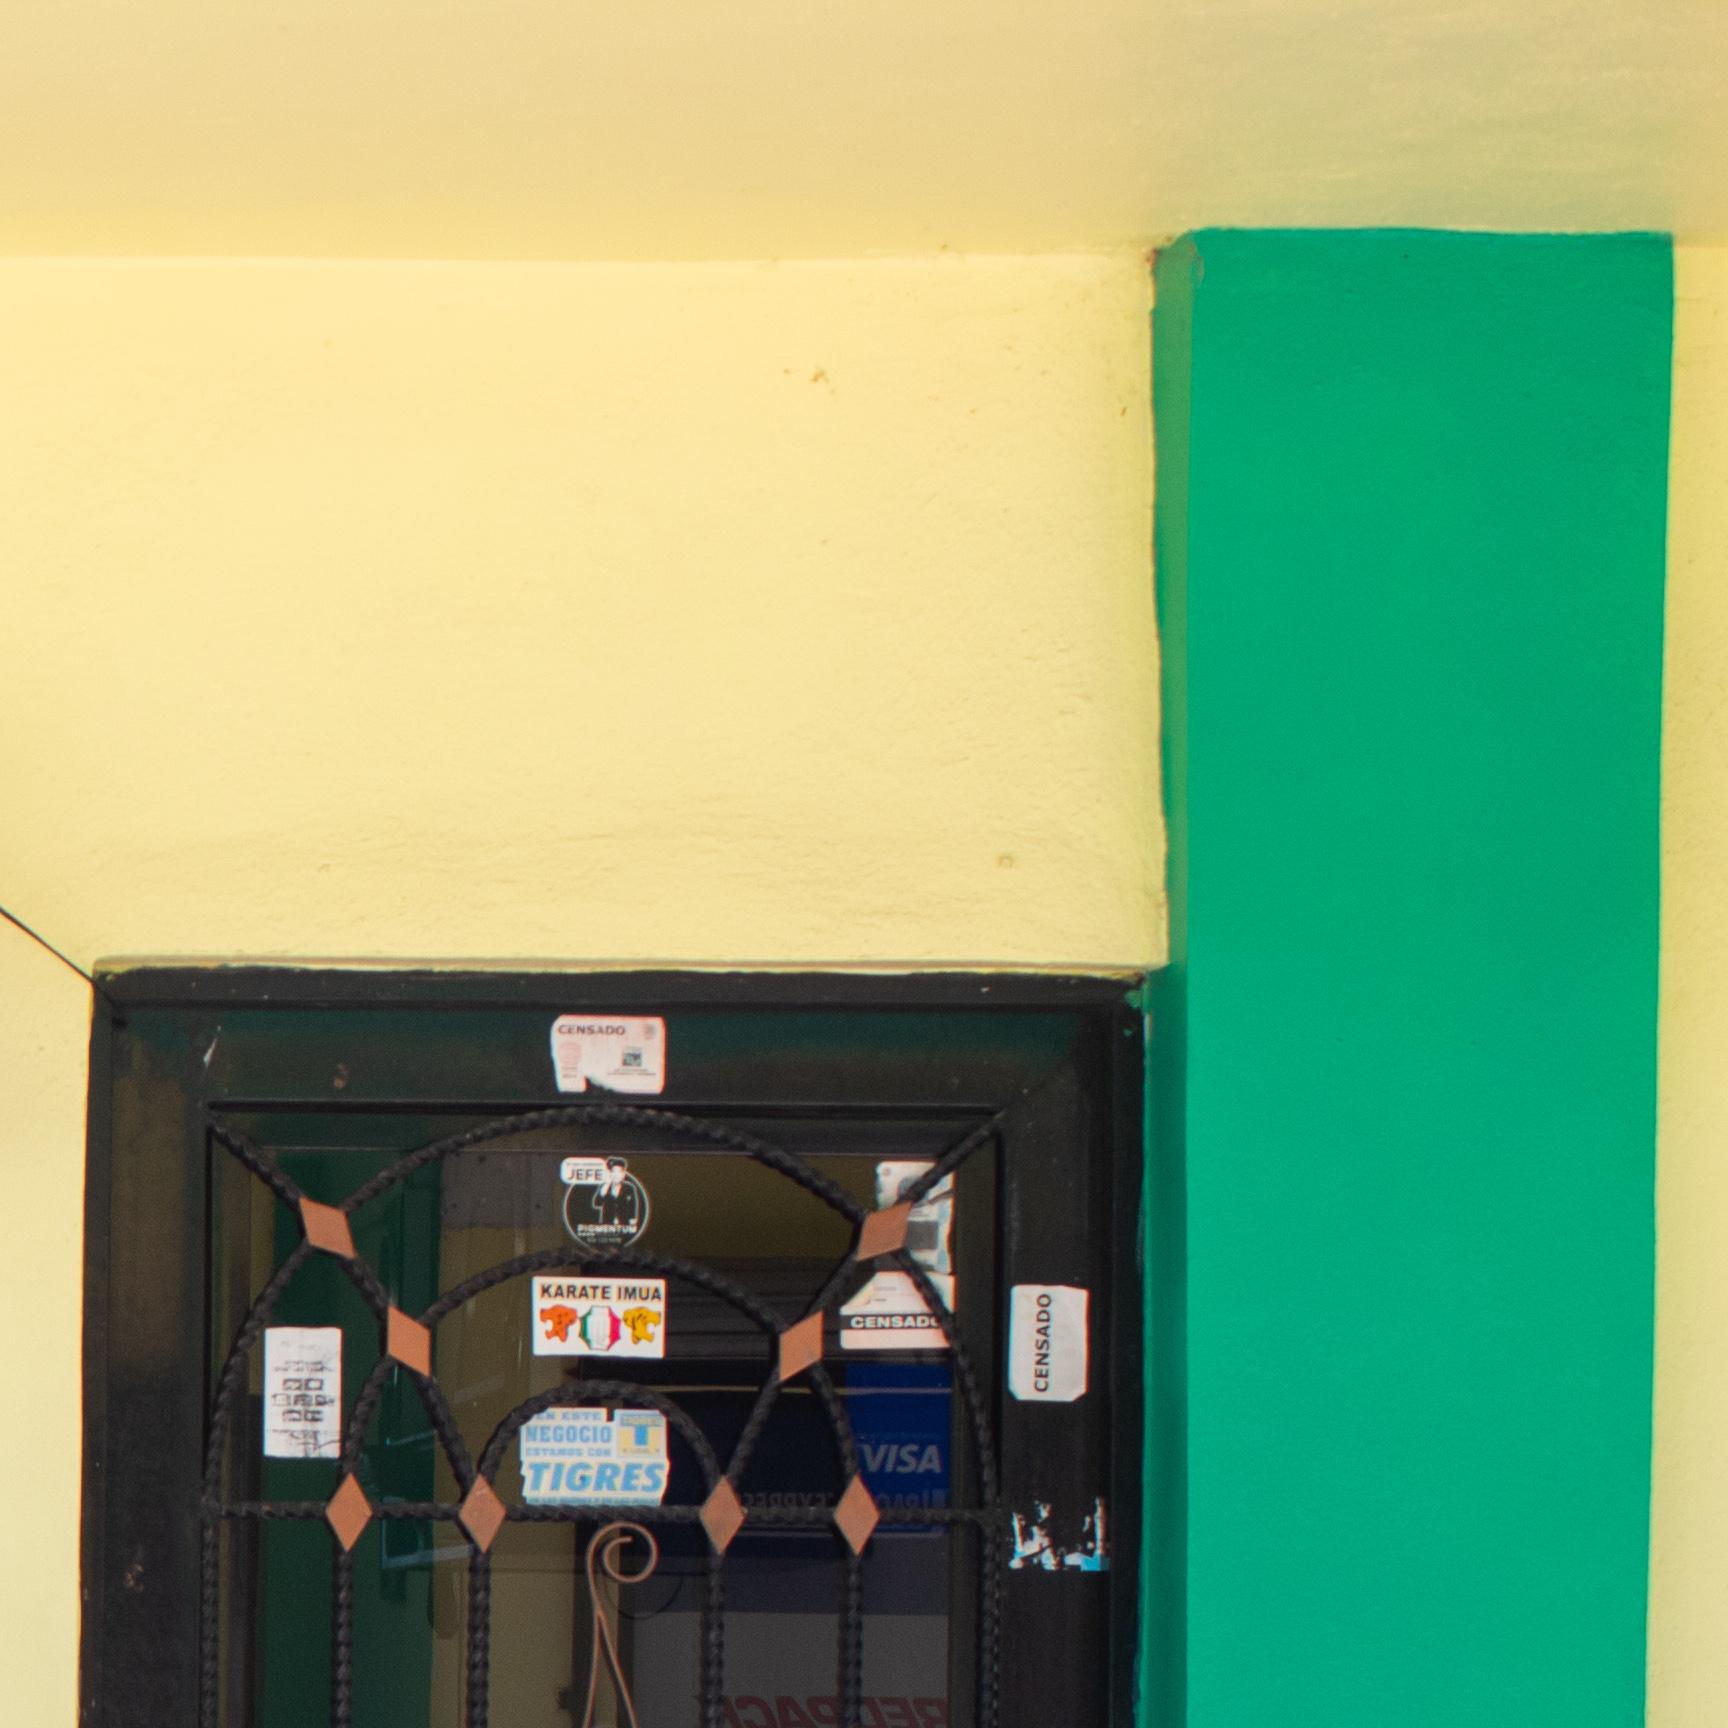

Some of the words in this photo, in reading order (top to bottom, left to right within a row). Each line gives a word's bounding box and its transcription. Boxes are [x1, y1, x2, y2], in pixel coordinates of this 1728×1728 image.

[558, 1024, 626, 1036] CENSADO
[567, 1168, 604, 1180] JEFE
[540, 1284, 612, 1300] KARATE
[617, 1285, 662, 1301] IMUA
[1034, 1292, 1053, 1393] CENSADO
[526, 1424, 612, 1443] NEGOCIO
[856, 1444, 942, 1474] VISA
[528, 1462, 665, 1492] TIGRES
